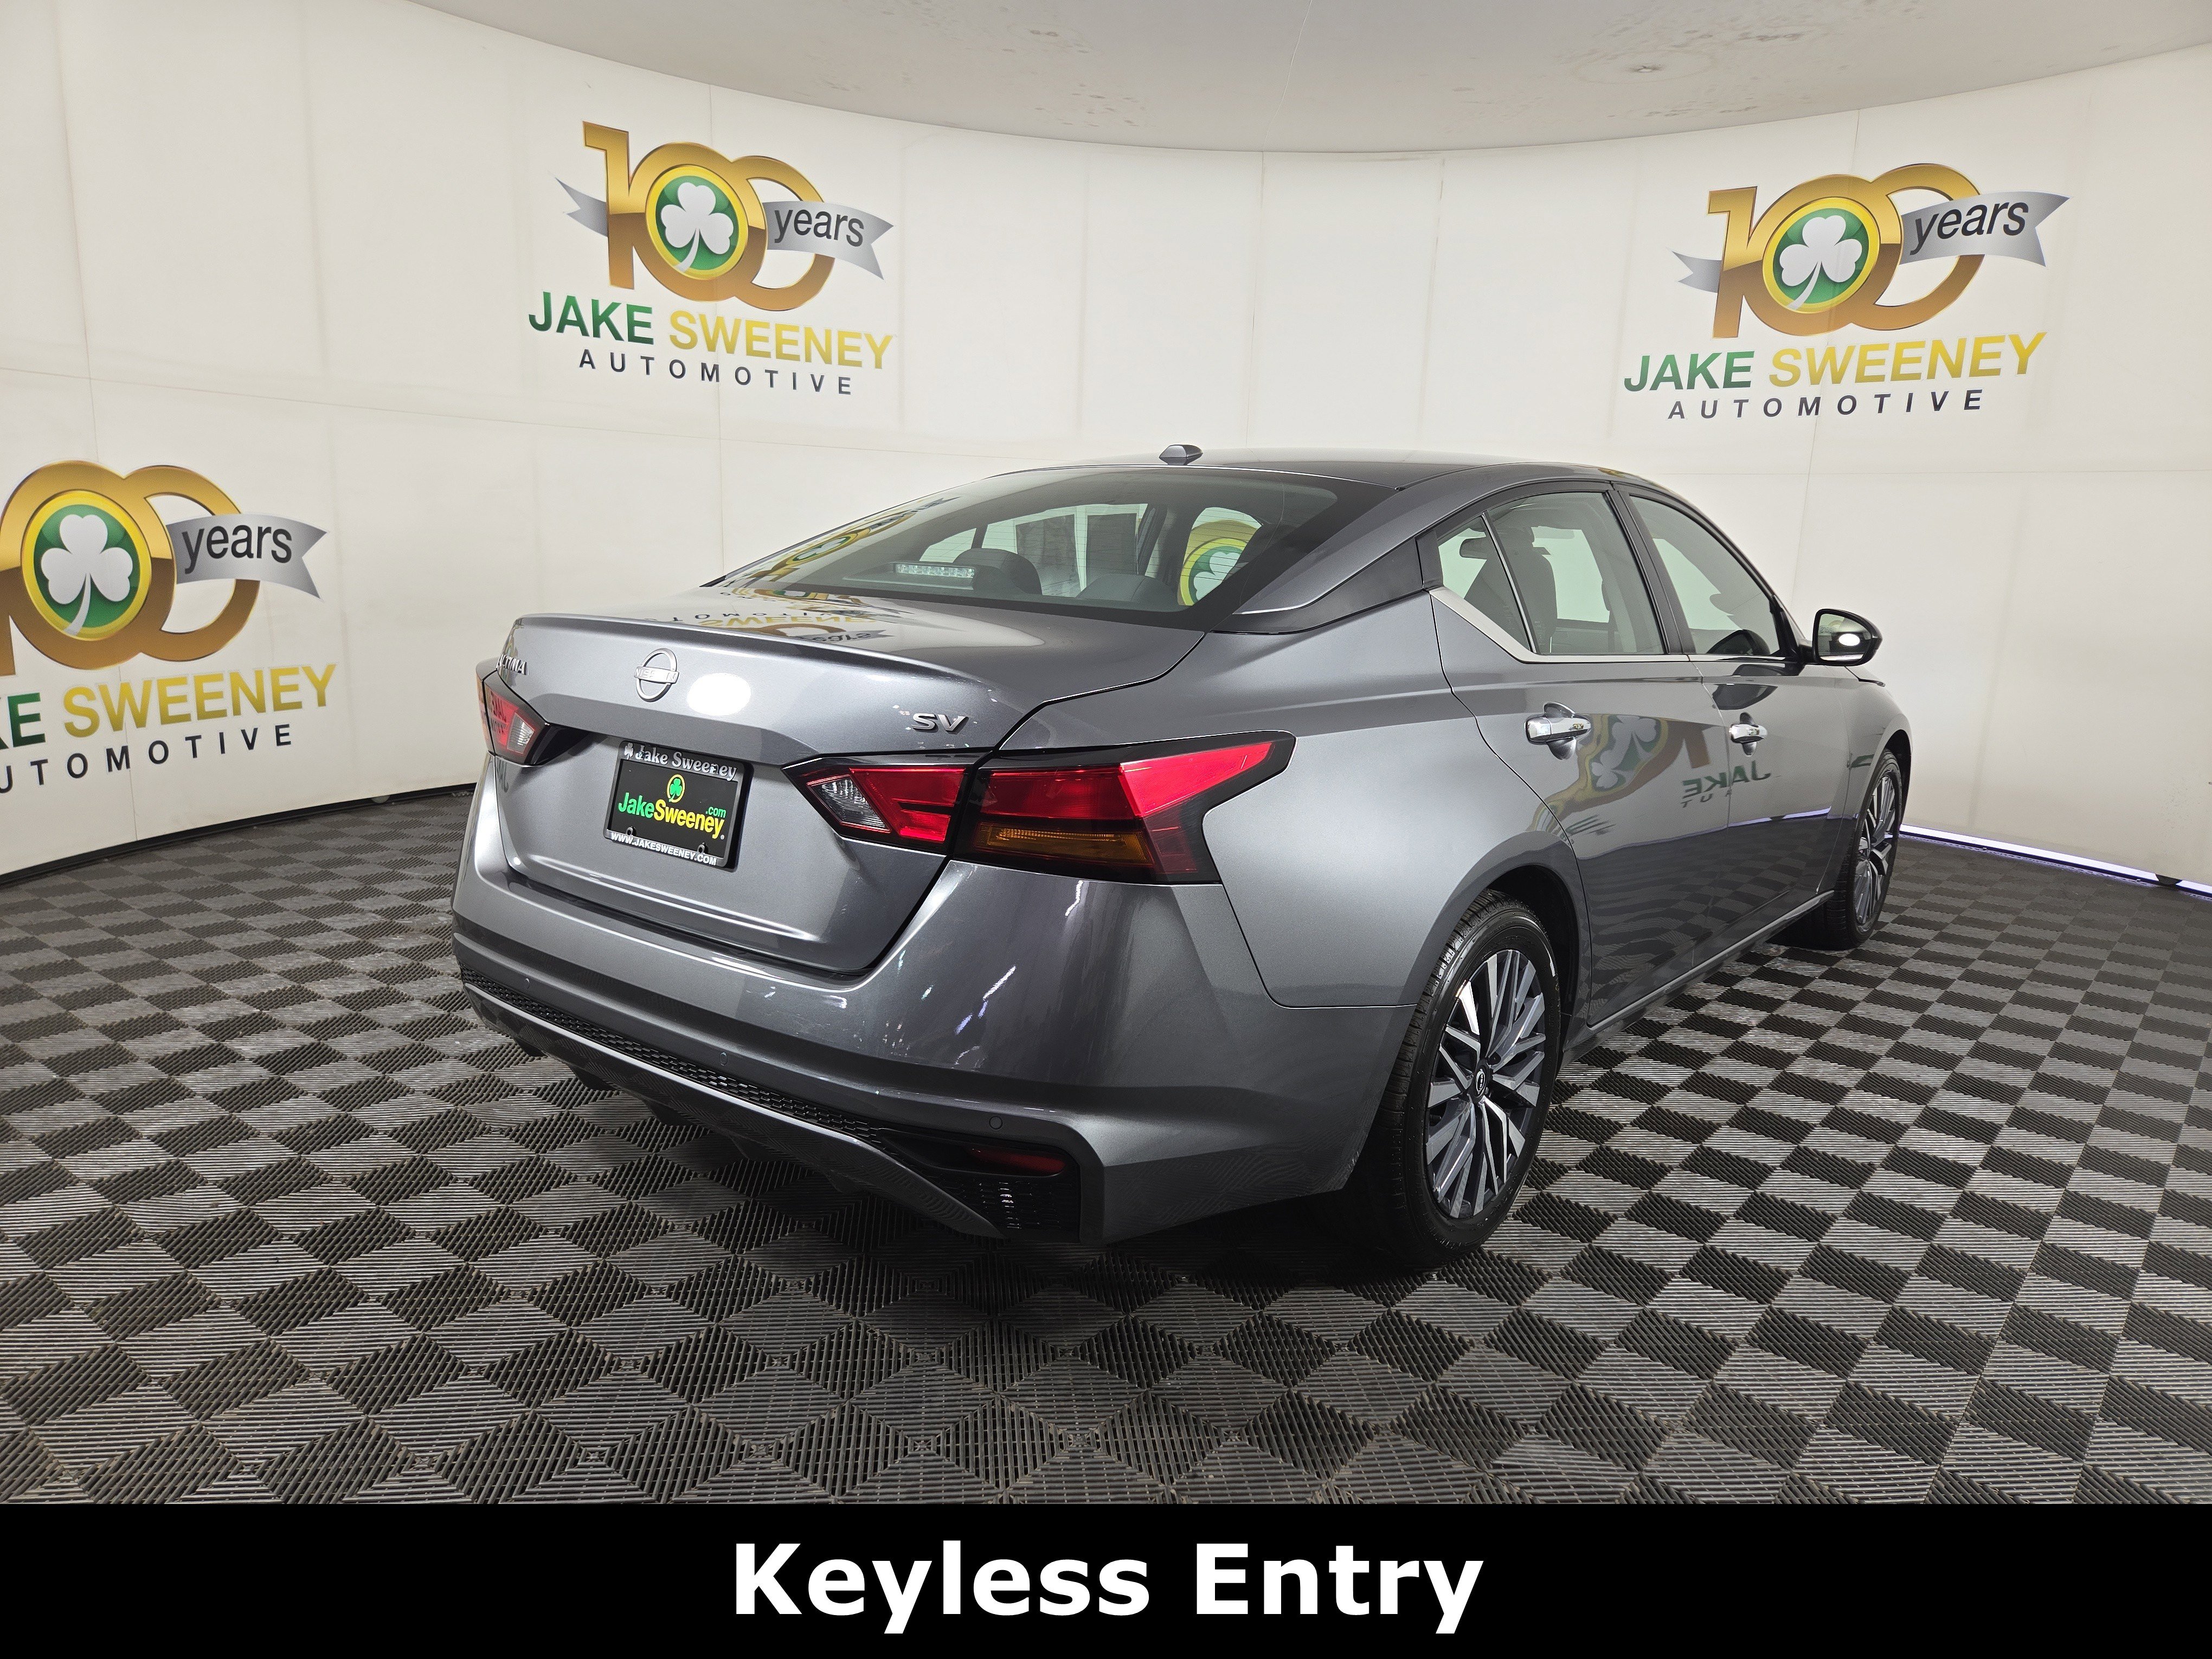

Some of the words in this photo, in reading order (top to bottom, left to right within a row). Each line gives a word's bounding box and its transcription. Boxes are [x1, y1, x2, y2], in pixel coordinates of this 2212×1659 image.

[582, 120, 836, 312] 100
[774, 209, 865, 247] years
[1909, 201, 2029, 256] years
[1707, 163, 1986, 339] 100
[528, 292, 654, 345] JAKE
[668, 310, 893, 370] SWEENEY
[578, 349, 852, 395] AUTOMOTIVE
[1624, 350, 1755, 392] JAKE
[1769, 331, 2048, 388] SWEENEY
[1668, 389, 1984, 420] AUTOMOTIVE
[182, 524, 293, 574] years
[62, 664, 336, 738] SWEENEY
[911, 712, 967, 732] SV
[635, 745, 668, 766] Jake
[672, 751, 737, 781] Sweeney
[611, 832, 717, 866] WWW.JAKESWEENEY.COM
